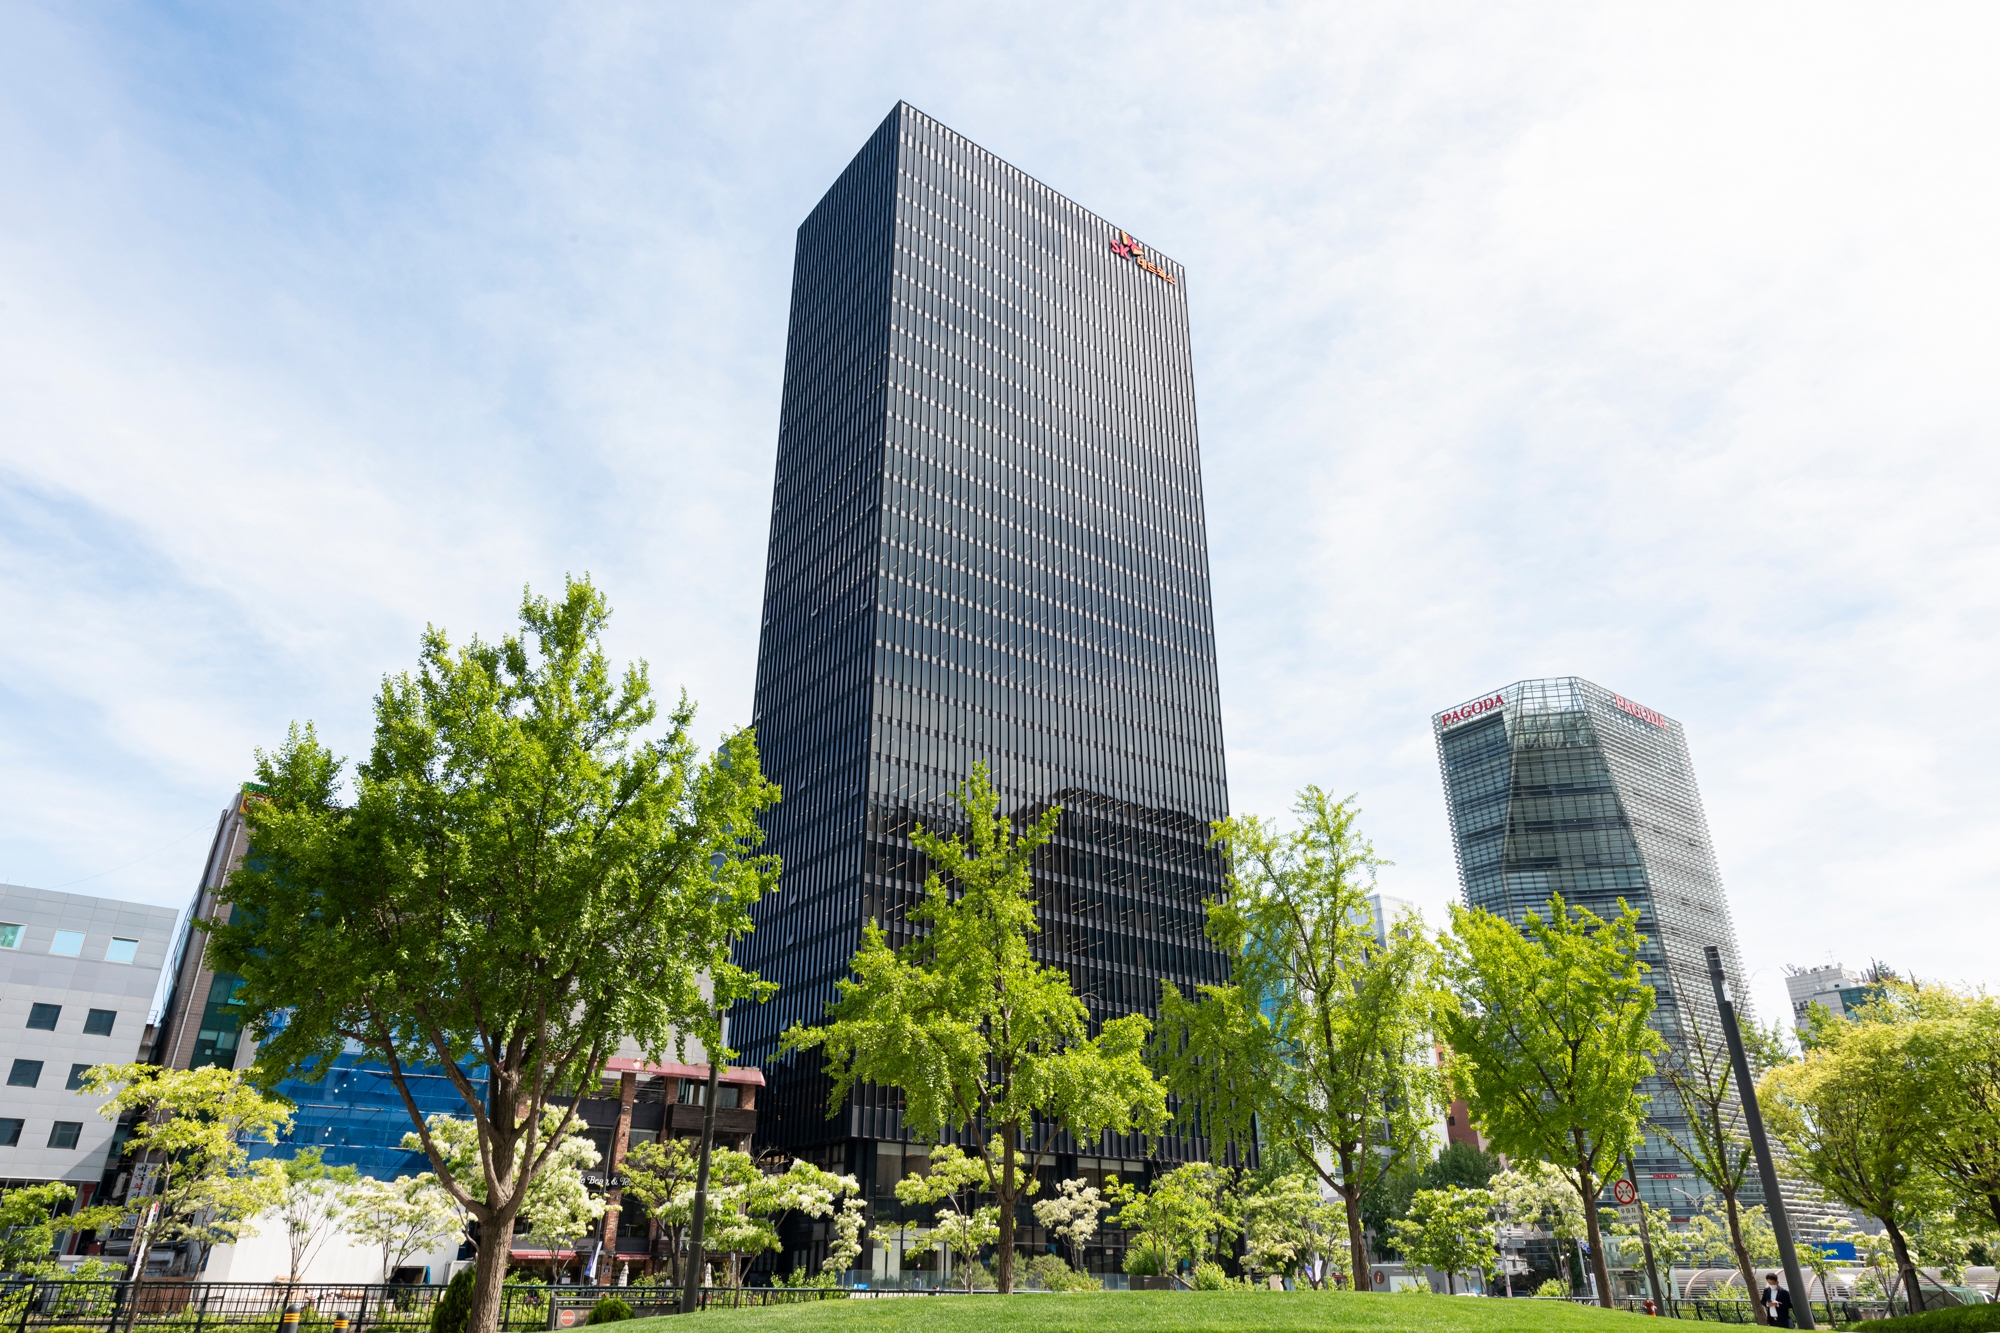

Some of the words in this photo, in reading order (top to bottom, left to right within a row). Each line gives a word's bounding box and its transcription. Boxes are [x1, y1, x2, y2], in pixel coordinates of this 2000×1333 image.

[1110, 239, 1130, 260] SK
[1441, 694, 1505, 726] PAGODA
[1613, 693, 1668, 730] PAGODA
